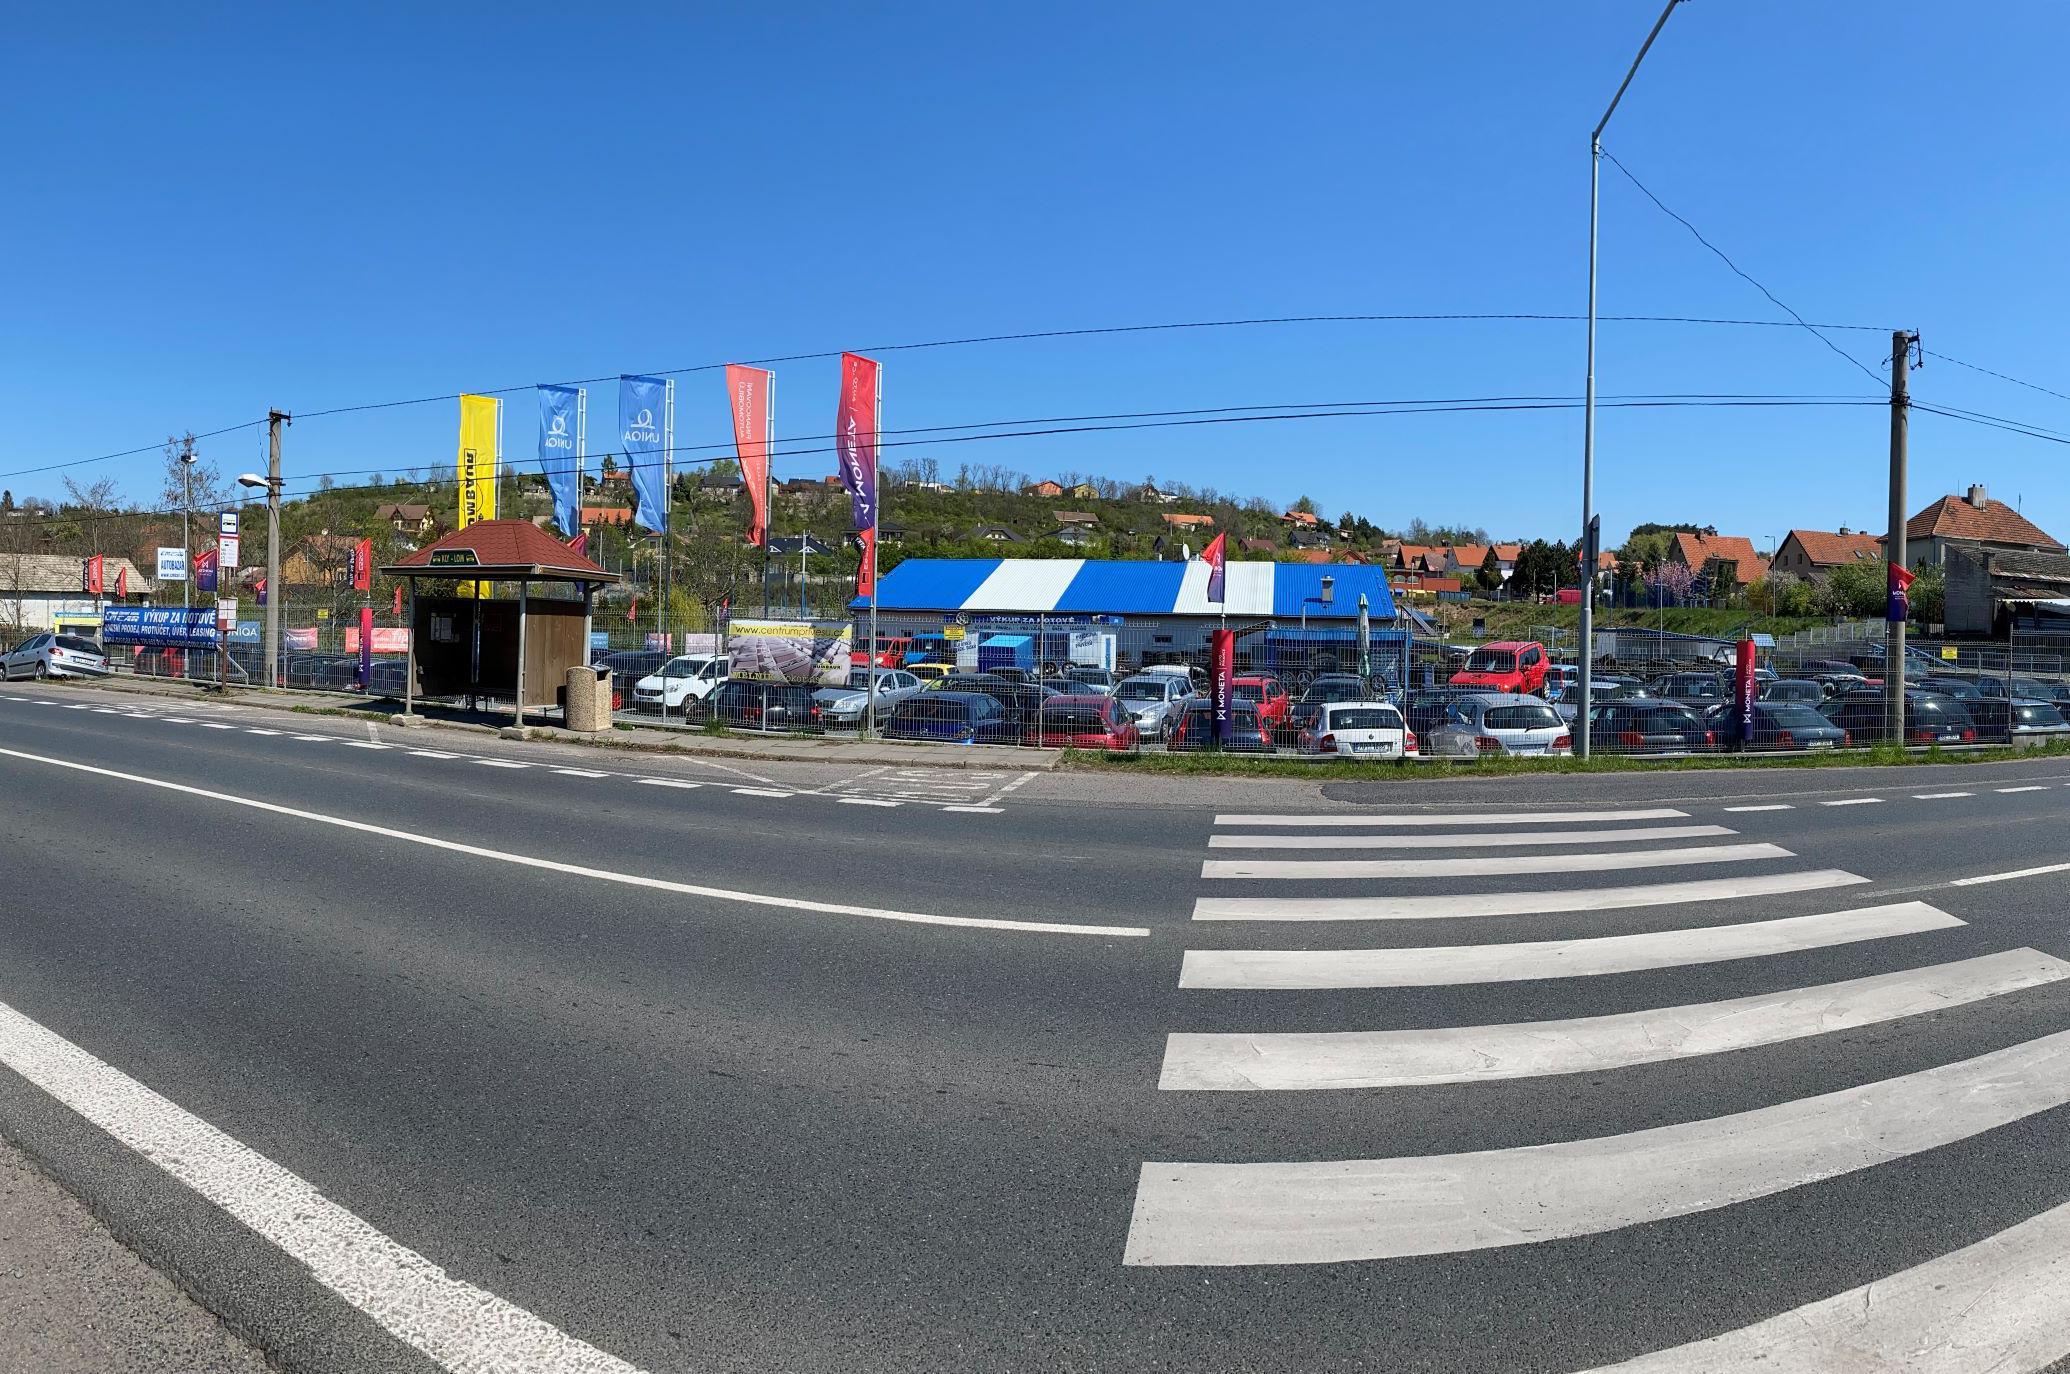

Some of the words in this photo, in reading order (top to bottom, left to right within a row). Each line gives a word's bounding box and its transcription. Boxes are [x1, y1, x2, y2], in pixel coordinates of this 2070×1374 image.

[160, 560, 185, 570] AUTOBAZAR
[143, 609, 169, 624] VÝKUP
[170, 611, 181, 624] ZA
[182, 609, 216, 625] HOTOVÉ
[121, 624, 140, 636] PRODEJ,
[172, 624, 188, 638] ÚVĚR,
[189, 627, 216, 638] LEASING
[735, 626, 845, 638] www.centrumprivesu.cz
[1218, 671, 1226, 708] MONETA
